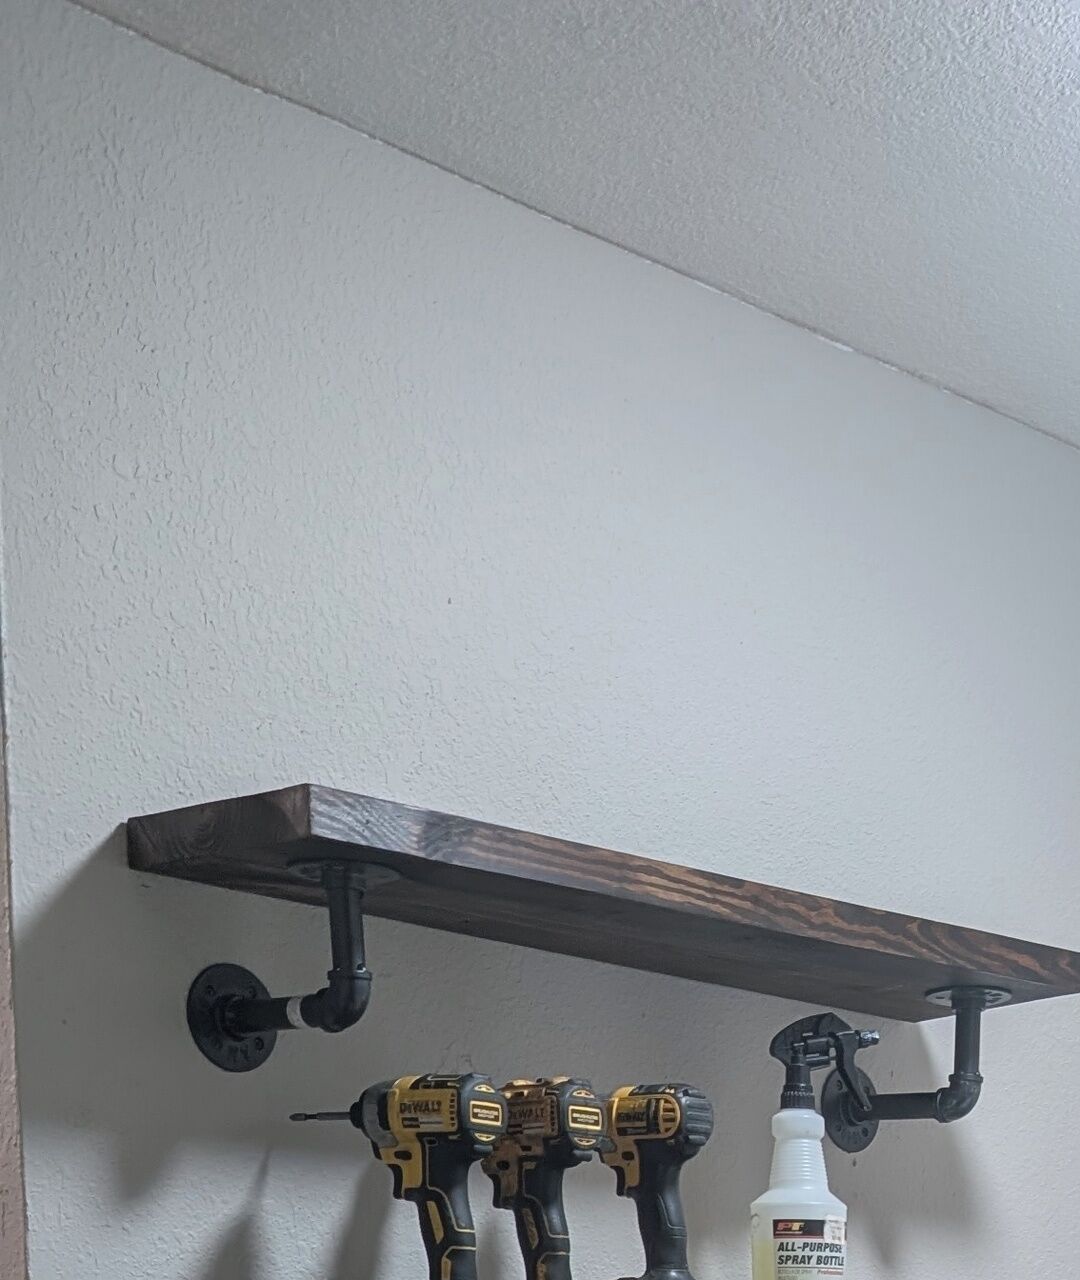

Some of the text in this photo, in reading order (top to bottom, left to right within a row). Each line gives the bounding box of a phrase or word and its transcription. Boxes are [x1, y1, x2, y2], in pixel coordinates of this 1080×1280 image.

[777, 1241, 843, 1253] ALL-PURPOSE
[777, 1254, 845, 1266] SPRAY BOTTLE
